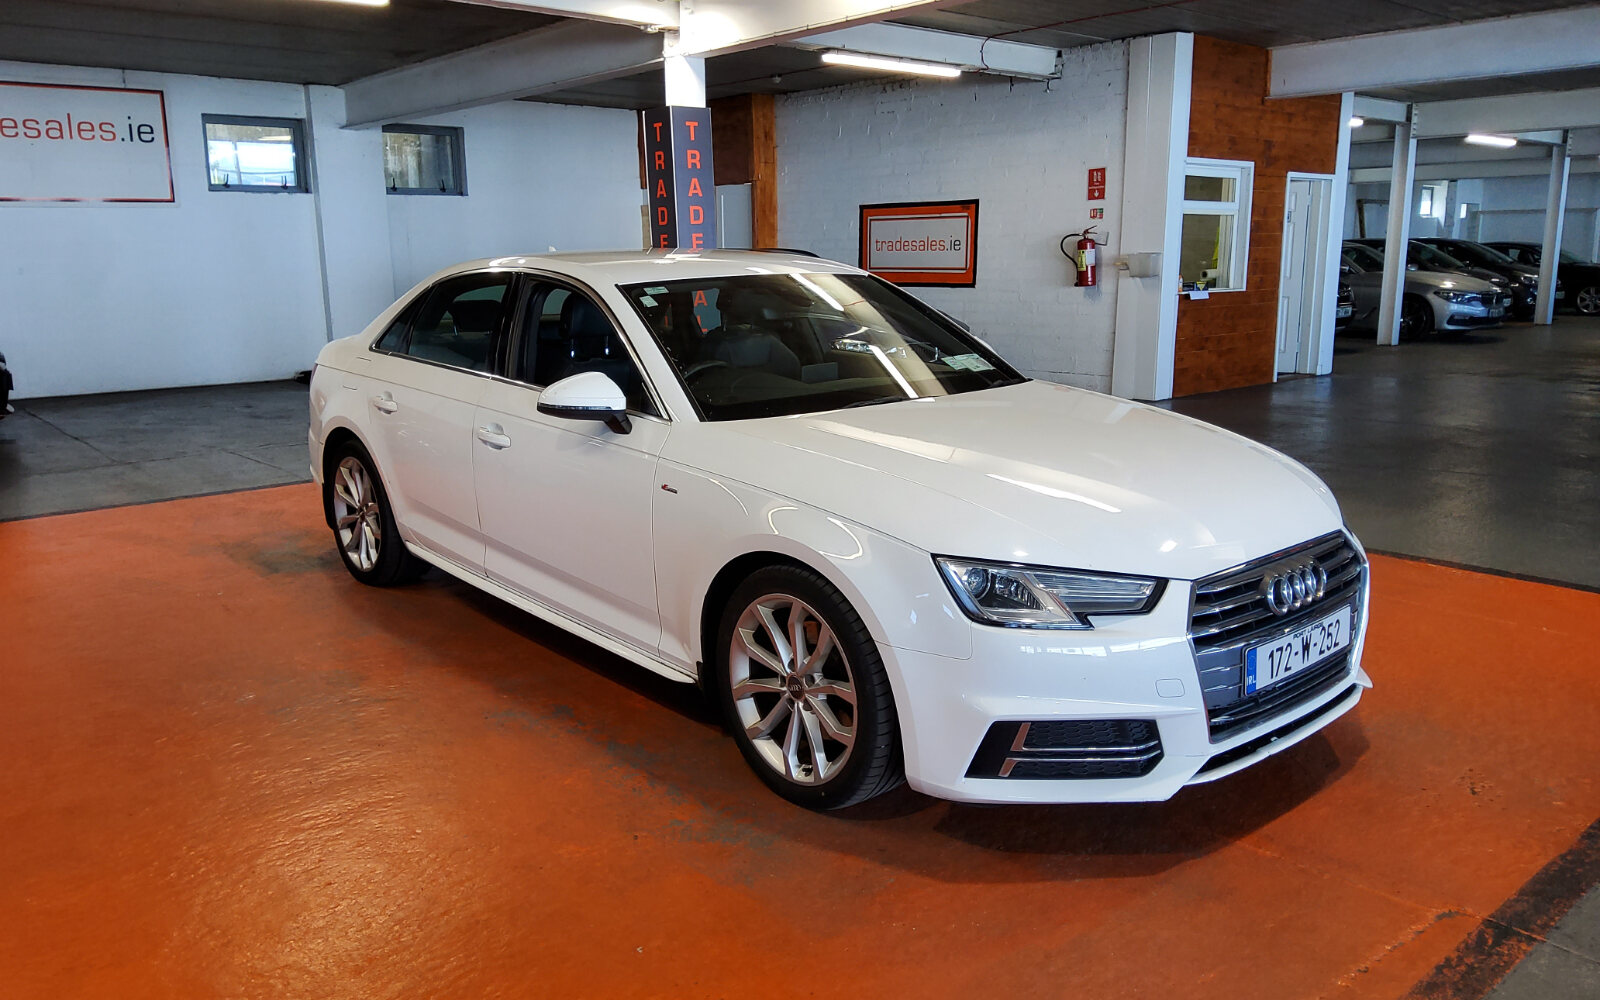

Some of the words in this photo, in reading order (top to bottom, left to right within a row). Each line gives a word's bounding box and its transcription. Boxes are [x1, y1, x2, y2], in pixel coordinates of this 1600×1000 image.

[0, 113, 155, 143] esales.ie
[653, 122, 668, 248] TRADE
[685, 121, 704, 248] TRADE
[875, 235, 962, 252] tradesales.ie
[1268, 619, 1340, 680] 172-W-252
[1246, 675, 1257, 686] IRL
